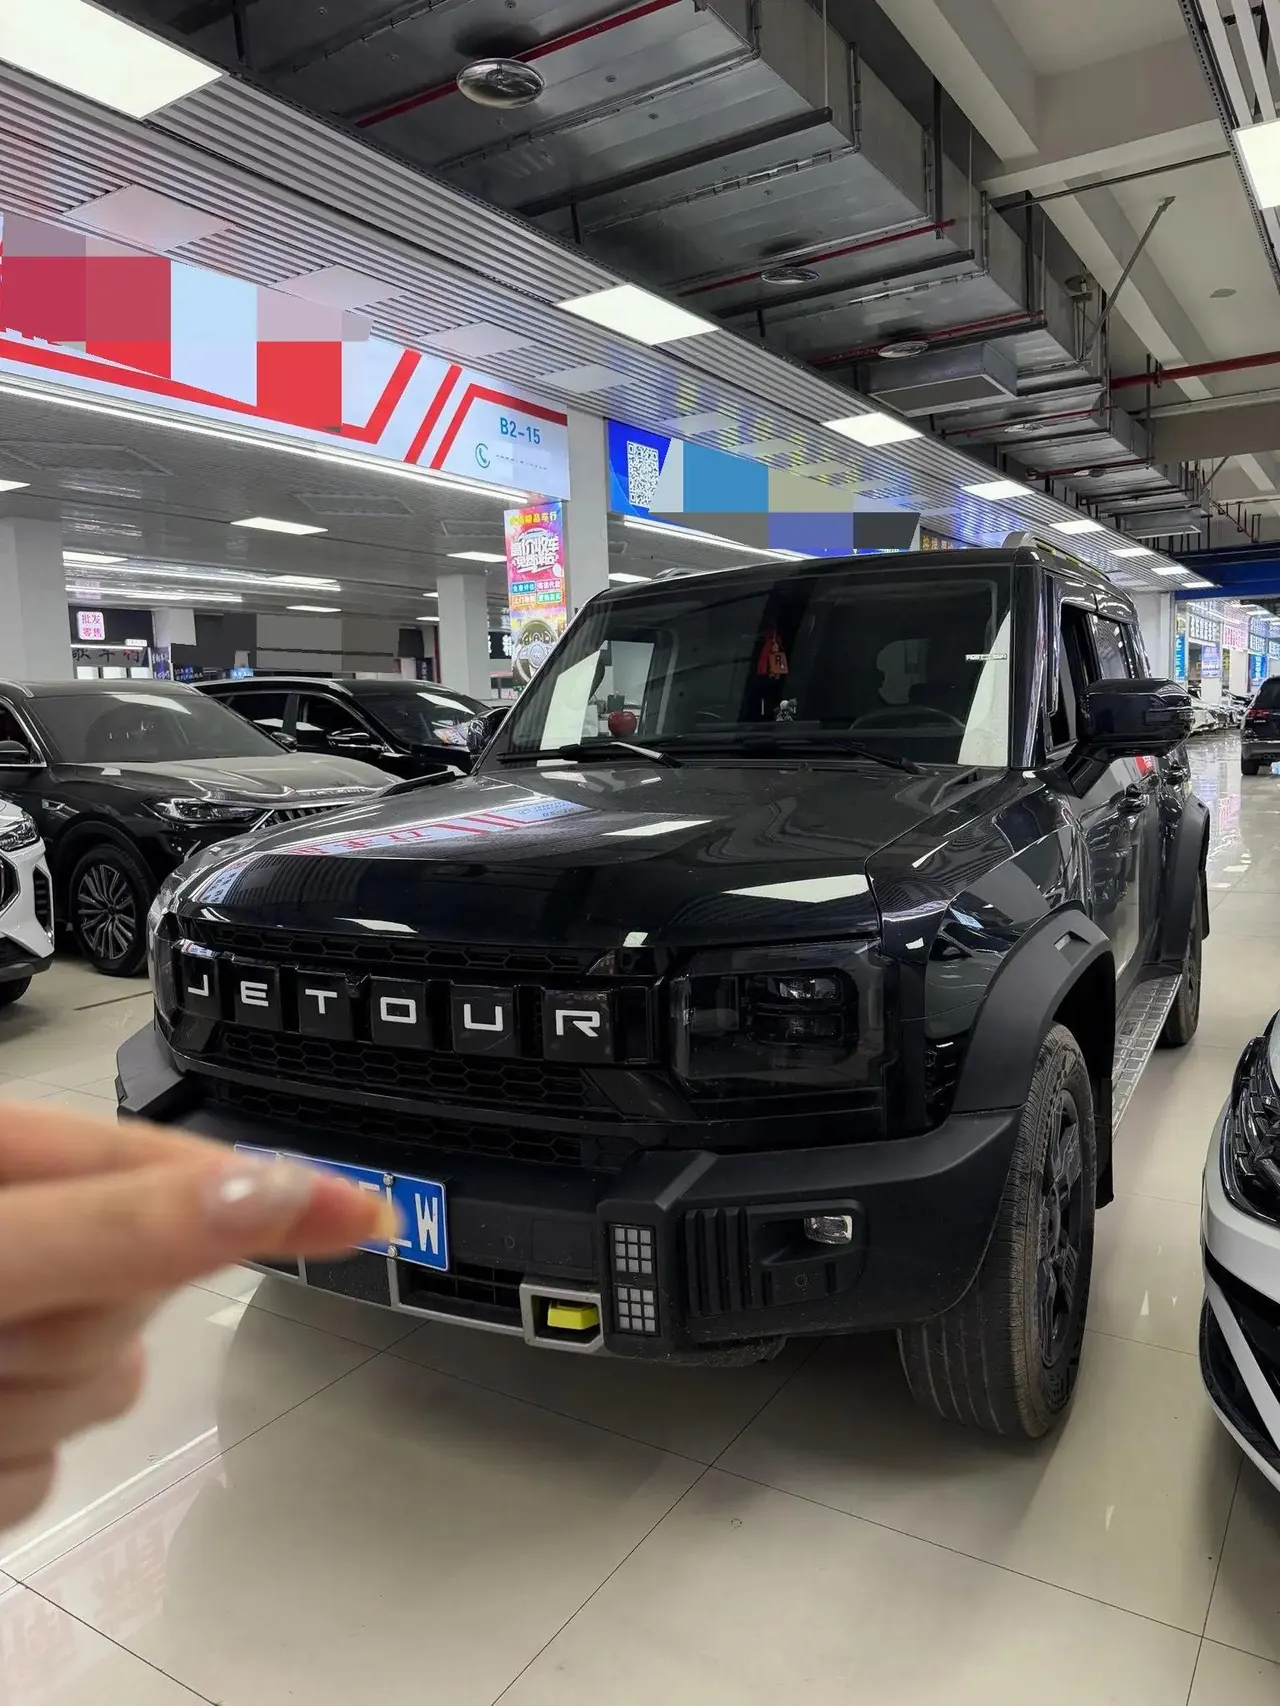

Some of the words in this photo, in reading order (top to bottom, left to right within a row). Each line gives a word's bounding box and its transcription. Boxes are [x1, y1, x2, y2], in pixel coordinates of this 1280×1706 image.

[499, 416, 541, 446] B2-15
[81, 613, 101, 625] 批发
[82, 627, 102, 638] 零售
[187, 974, 601, 1038] JETOUR
